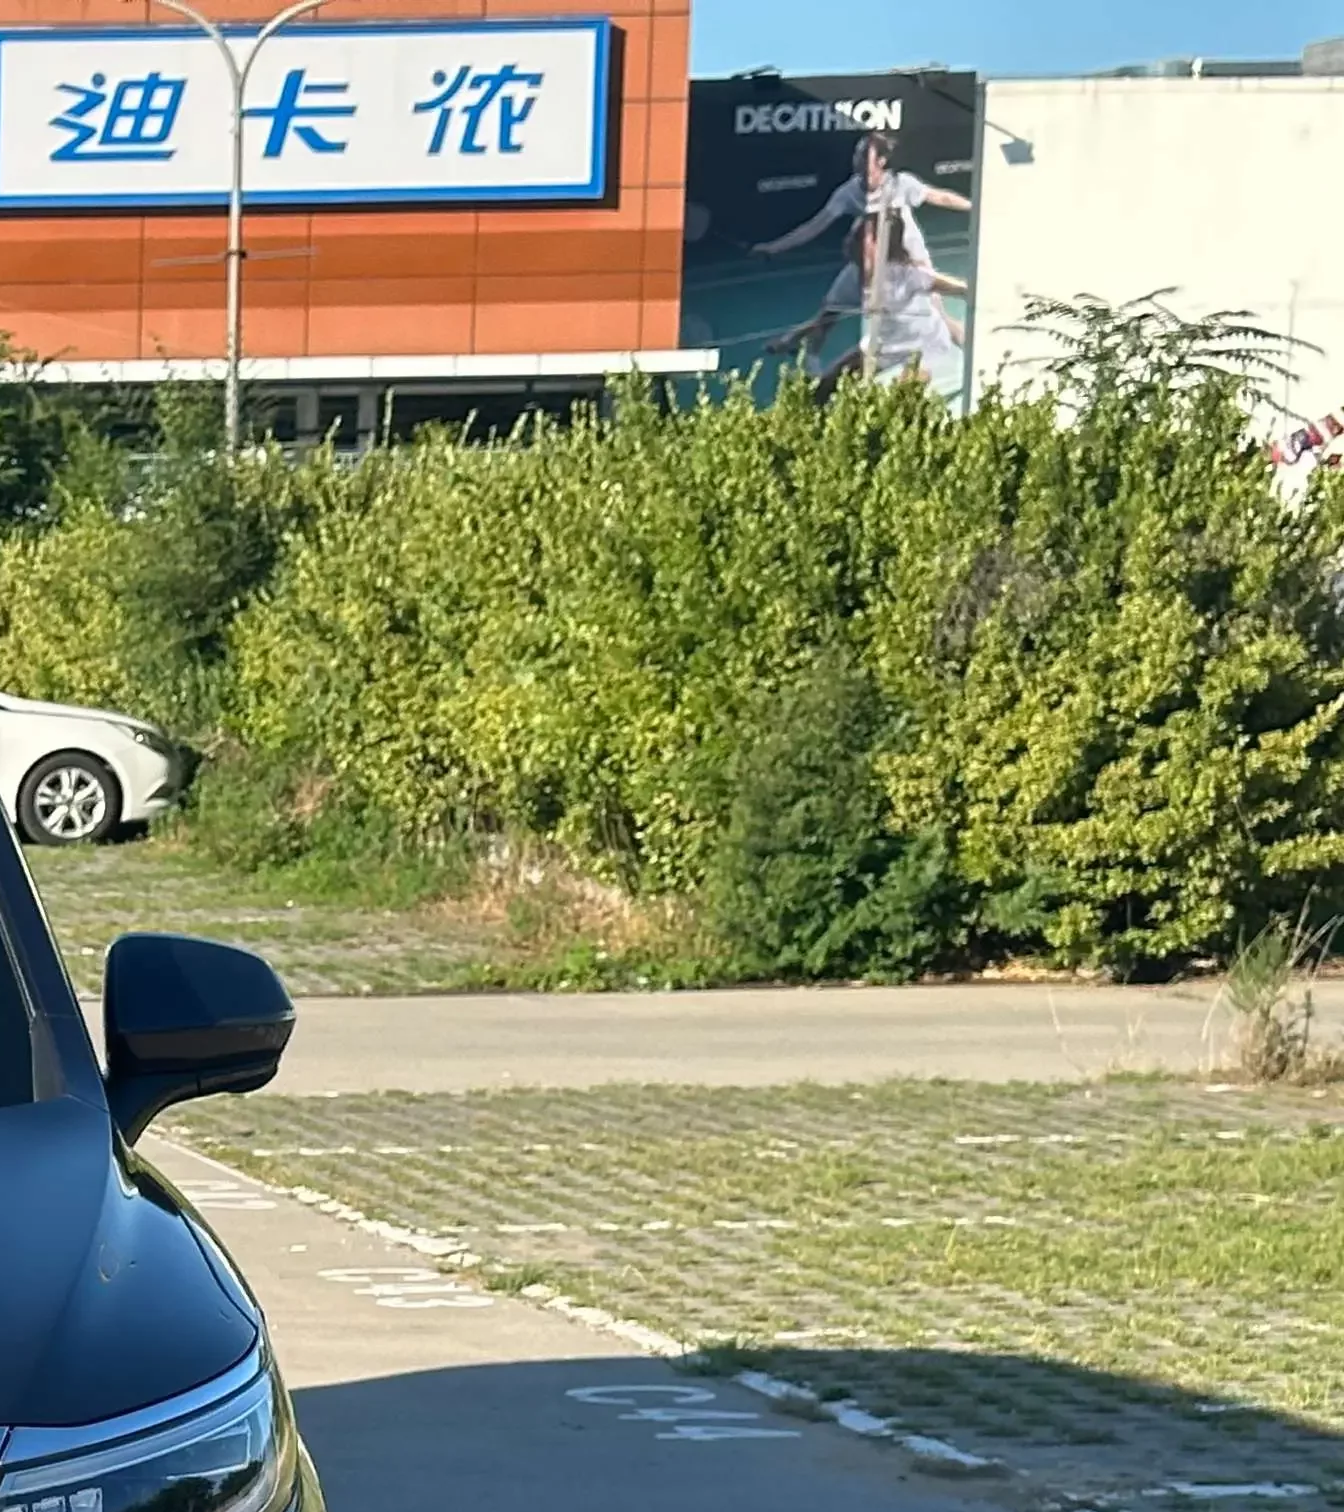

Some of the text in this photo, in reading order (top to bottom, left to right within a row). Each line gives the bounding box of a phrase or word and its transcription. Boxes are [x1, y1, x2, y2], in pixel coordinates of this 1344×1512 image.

[47, 63, 545, 162] 迪卡侬
[734, 98, 902, 135] DECATHLON
